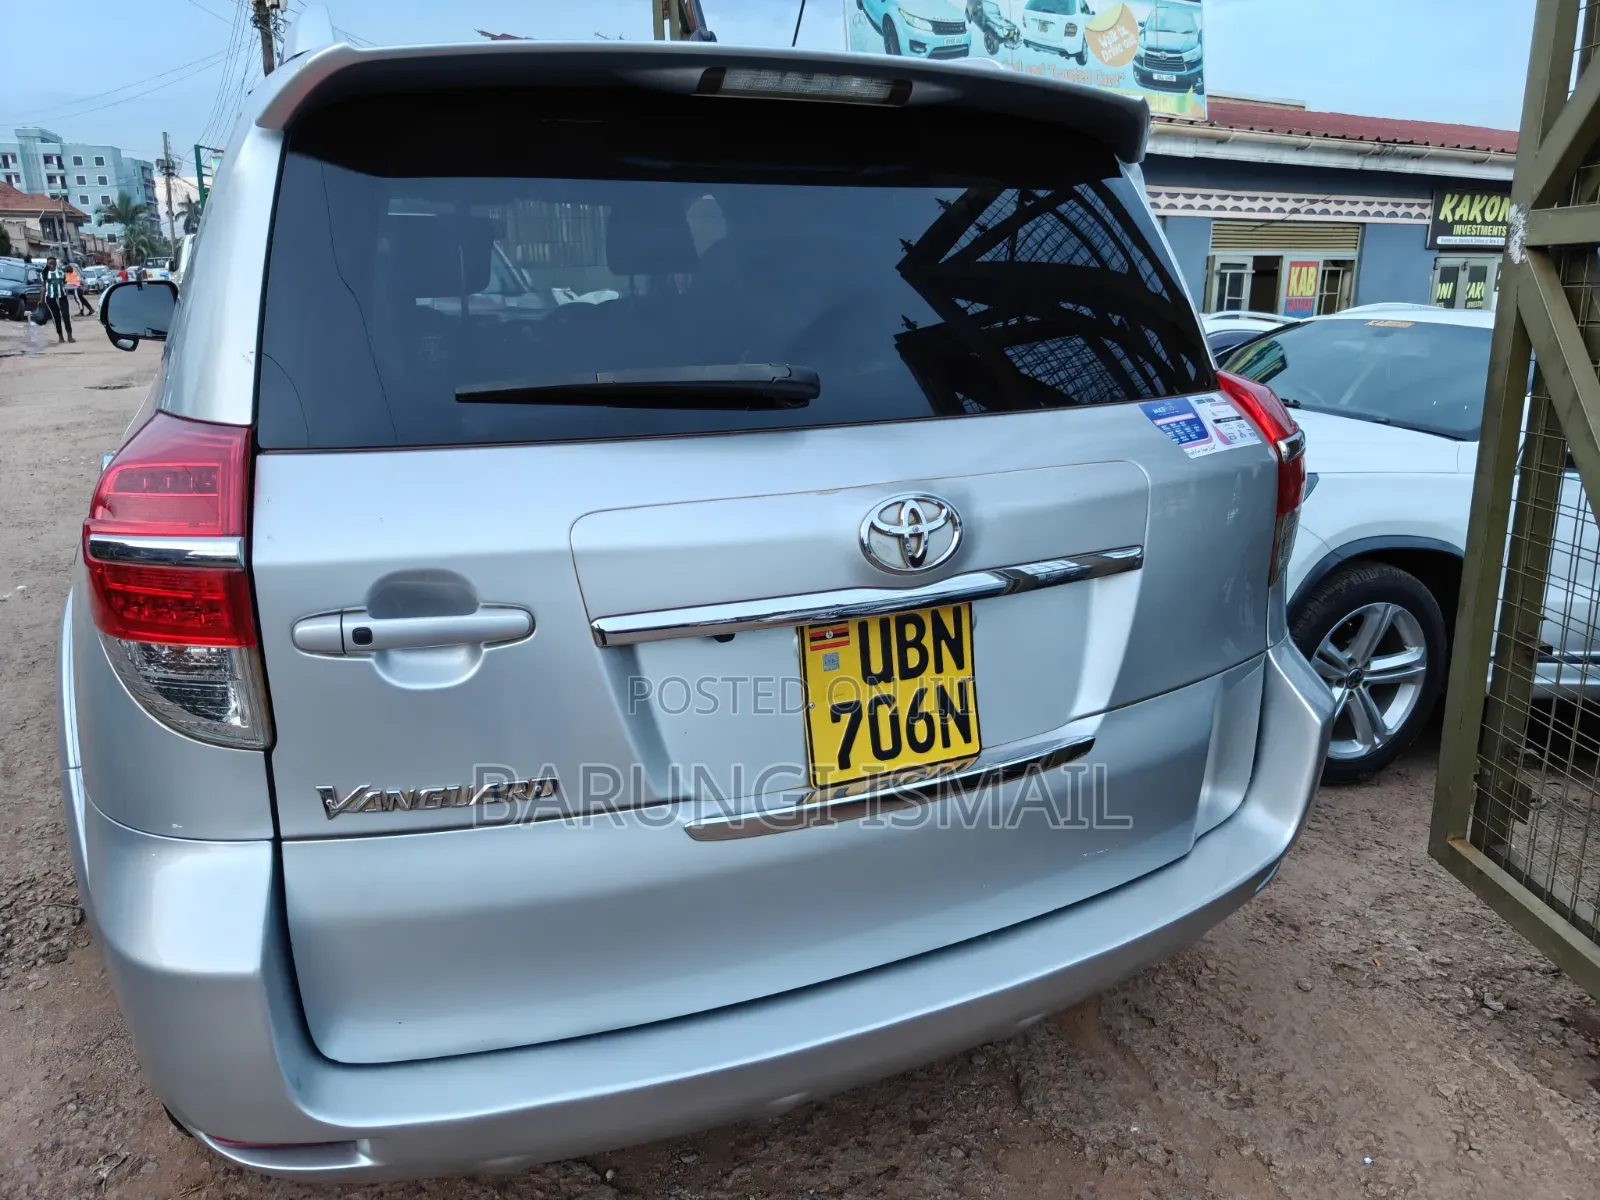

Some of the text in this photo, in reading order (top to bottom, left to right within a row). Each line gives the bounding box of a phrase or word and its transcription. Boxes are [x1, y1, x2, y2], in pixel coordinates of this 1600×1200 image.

[1453, 224, 1507, 236] INVESTMENTS
[1288, 266, 1317, 297] KAB
[858, 605, 965, 685] UBN
[830, 681, 972, 770] 706N
[315, 777, 559, 820] VANGUARD
